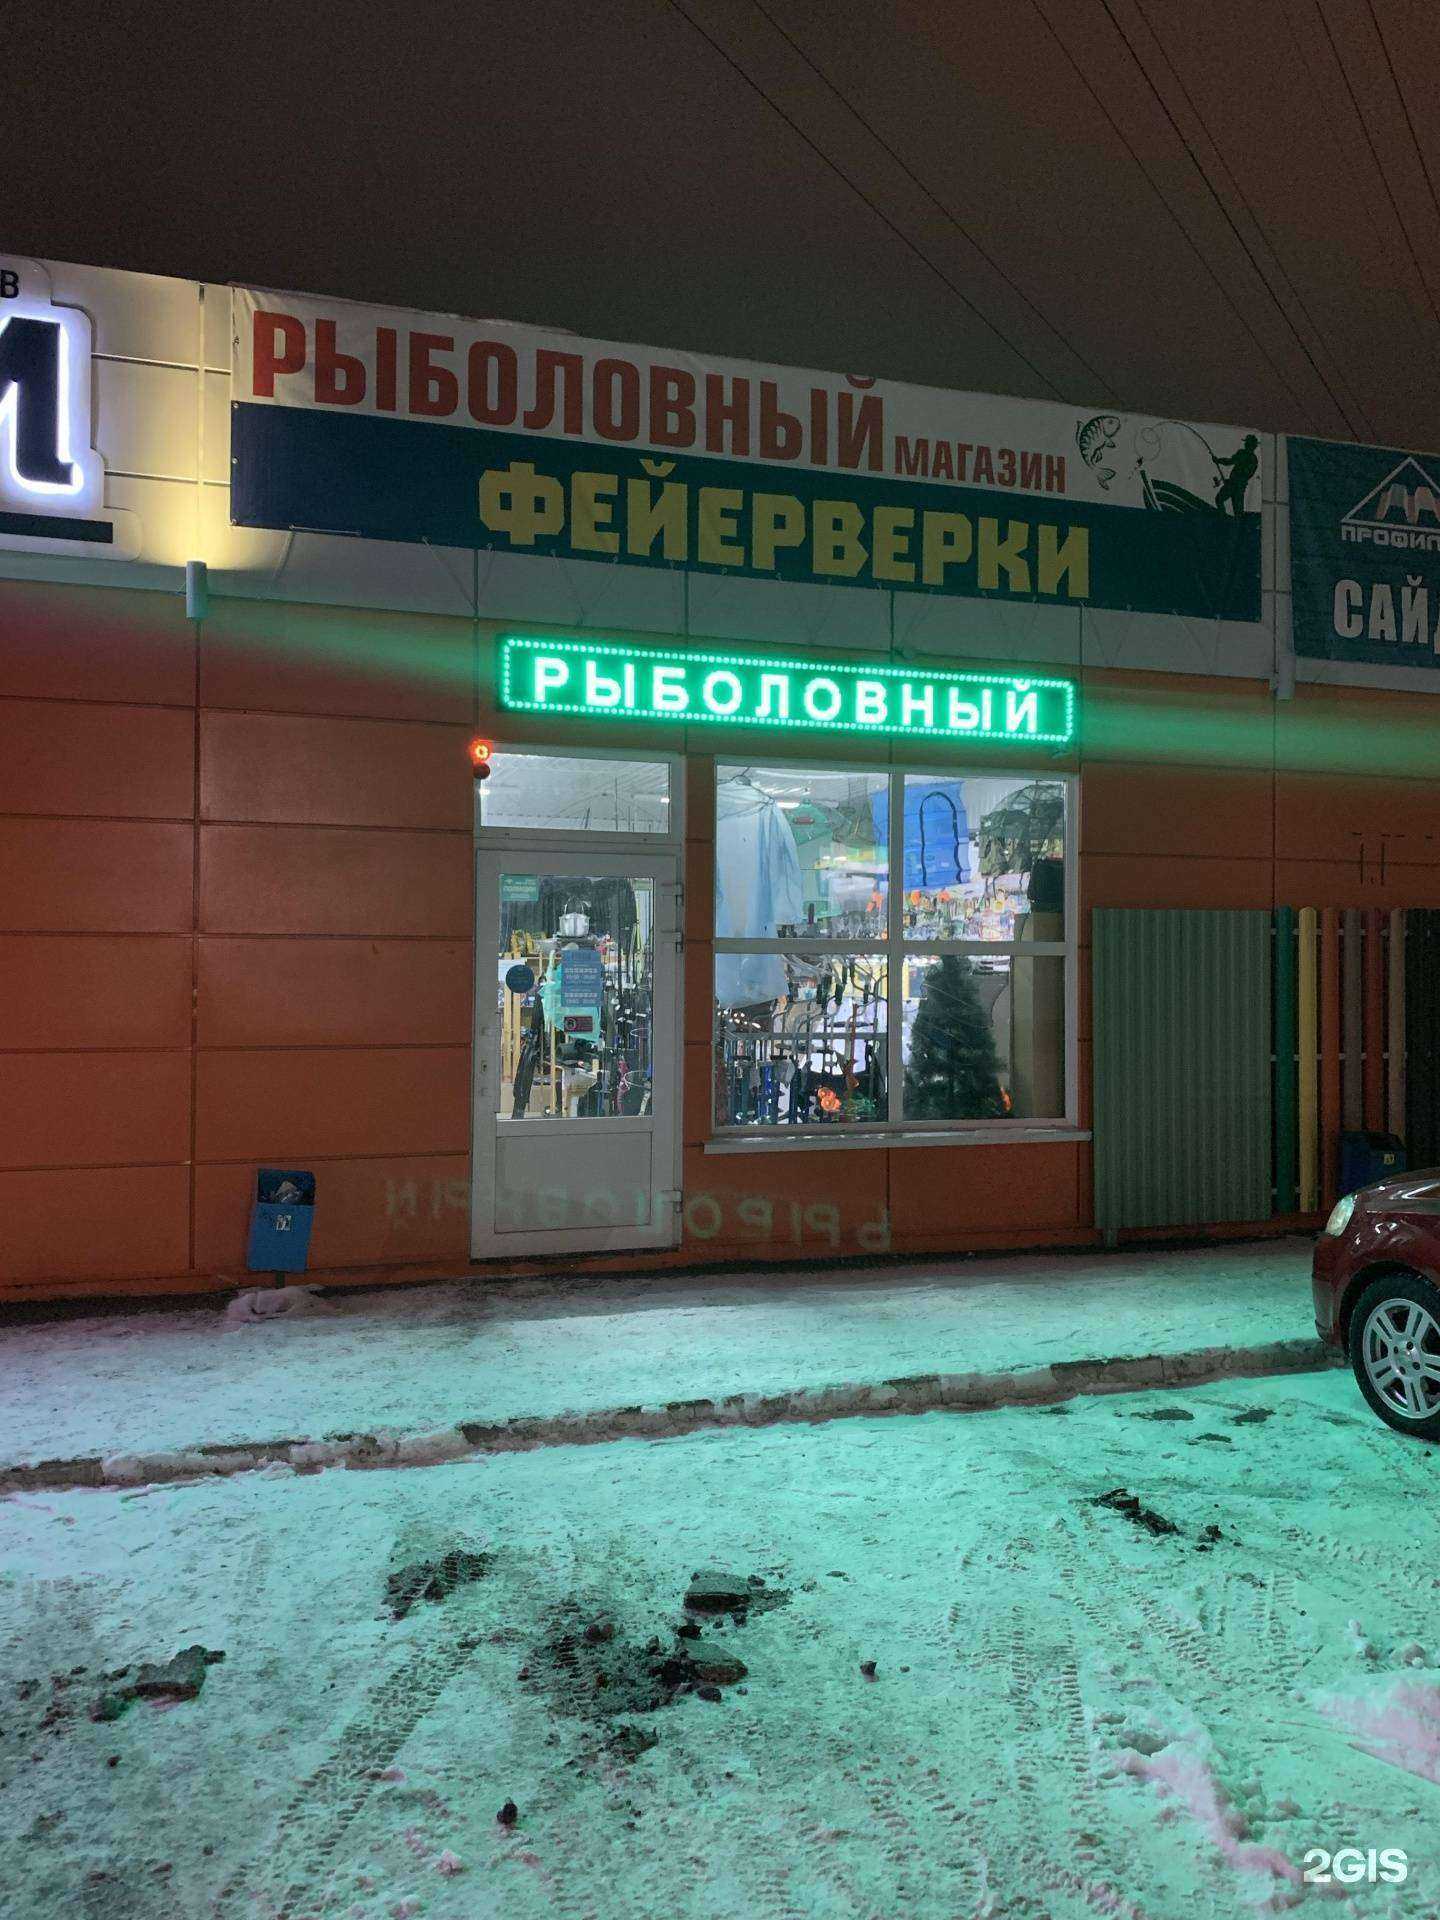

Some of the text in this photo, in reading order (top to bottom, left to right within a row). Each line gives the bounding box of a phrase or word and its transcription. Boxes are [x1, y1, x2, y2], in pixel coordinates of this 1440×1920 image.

[252, 310, 1067, 494] РЫБОЛОВНЫЙ МАГАЗИН
[478, 458, 1090, 598] ФЕЙЕРВЕРКИ
[1333, 574, 1440, 655] САЙ
[533, 656, 1039, 733] РЫБОЛОВНЫЙ
